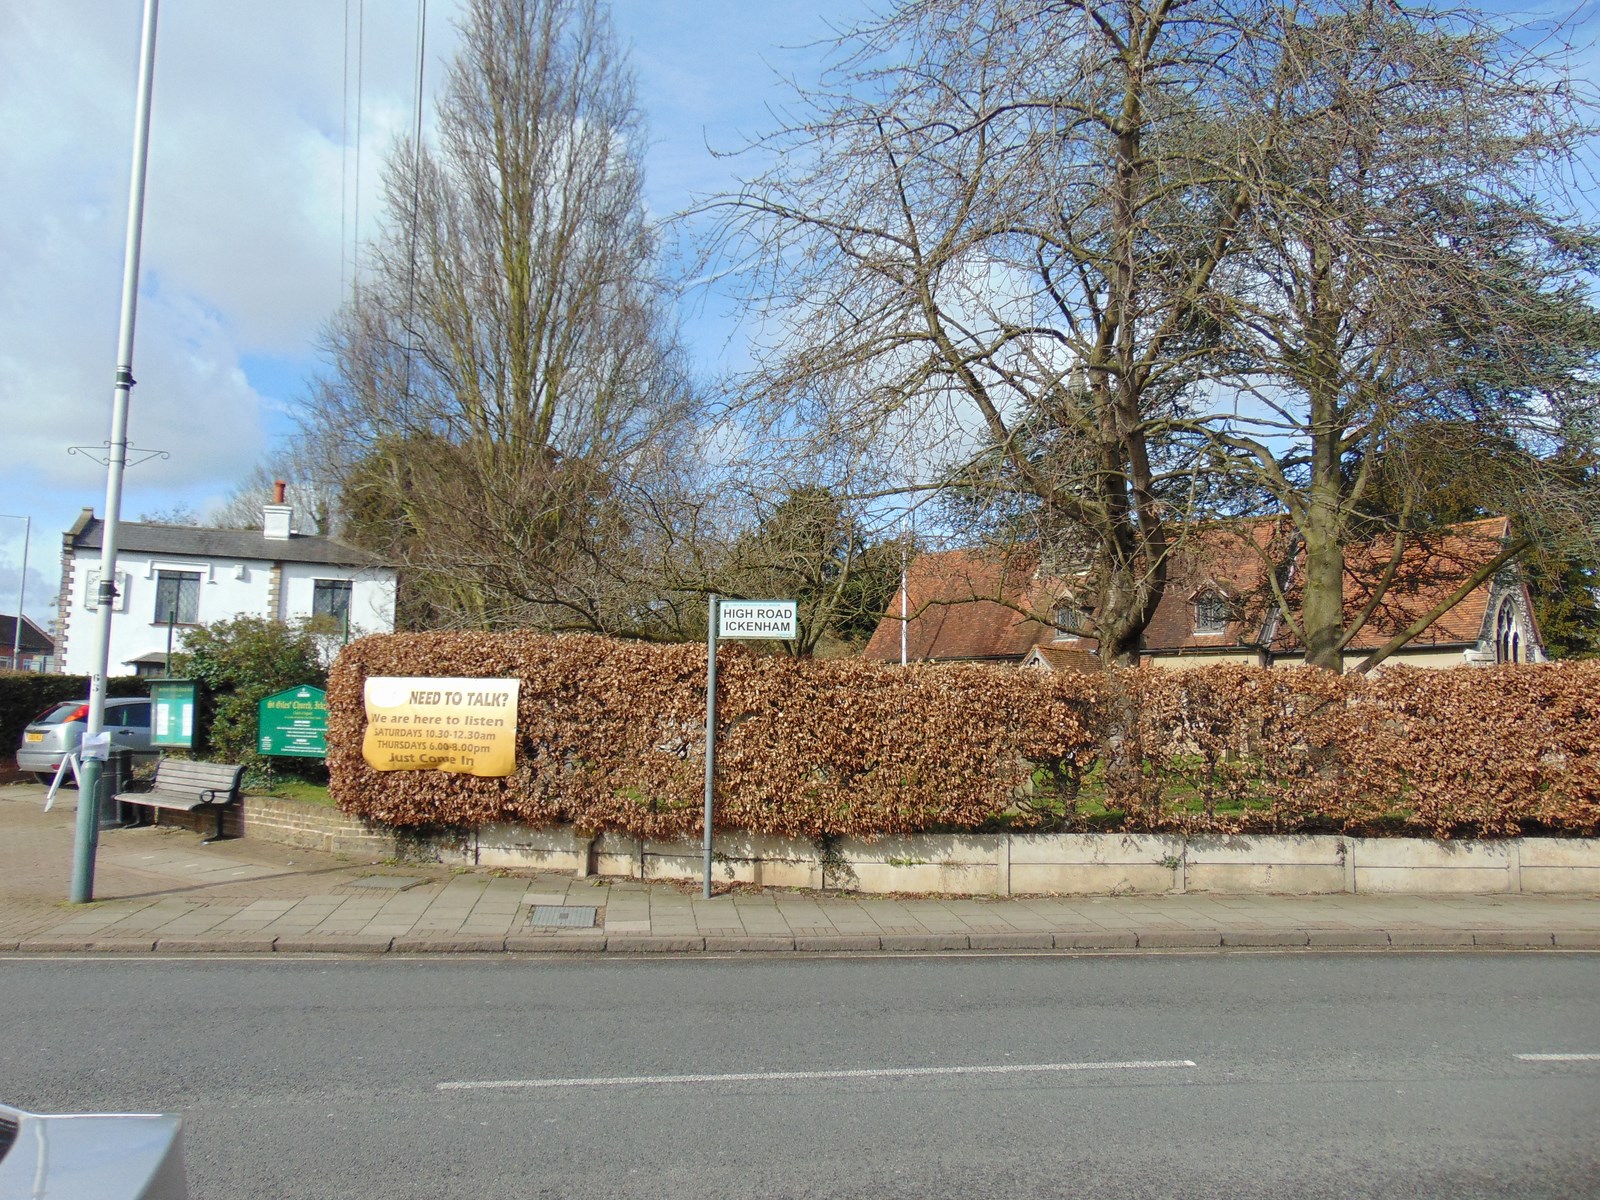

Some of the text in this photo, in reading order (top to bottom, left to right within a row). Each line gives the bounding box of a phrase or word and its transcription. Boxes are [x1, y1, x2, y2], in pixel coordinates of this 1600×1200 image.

[724, 609, 793, 619] HIGH ROAD
[725, 621, 790, 631] ICKENHAM
[409, 690, 509, 707] NEED TO TALK?
[371, 713, 504, 727] We are here to listen
[374, 728, 496, 741] SATURDAYS 10.30-12.30am
[377, 740, 491, 755] THURSDAYS 6.00-8.00pm
[388, 753, 475, 767] Just Come In
